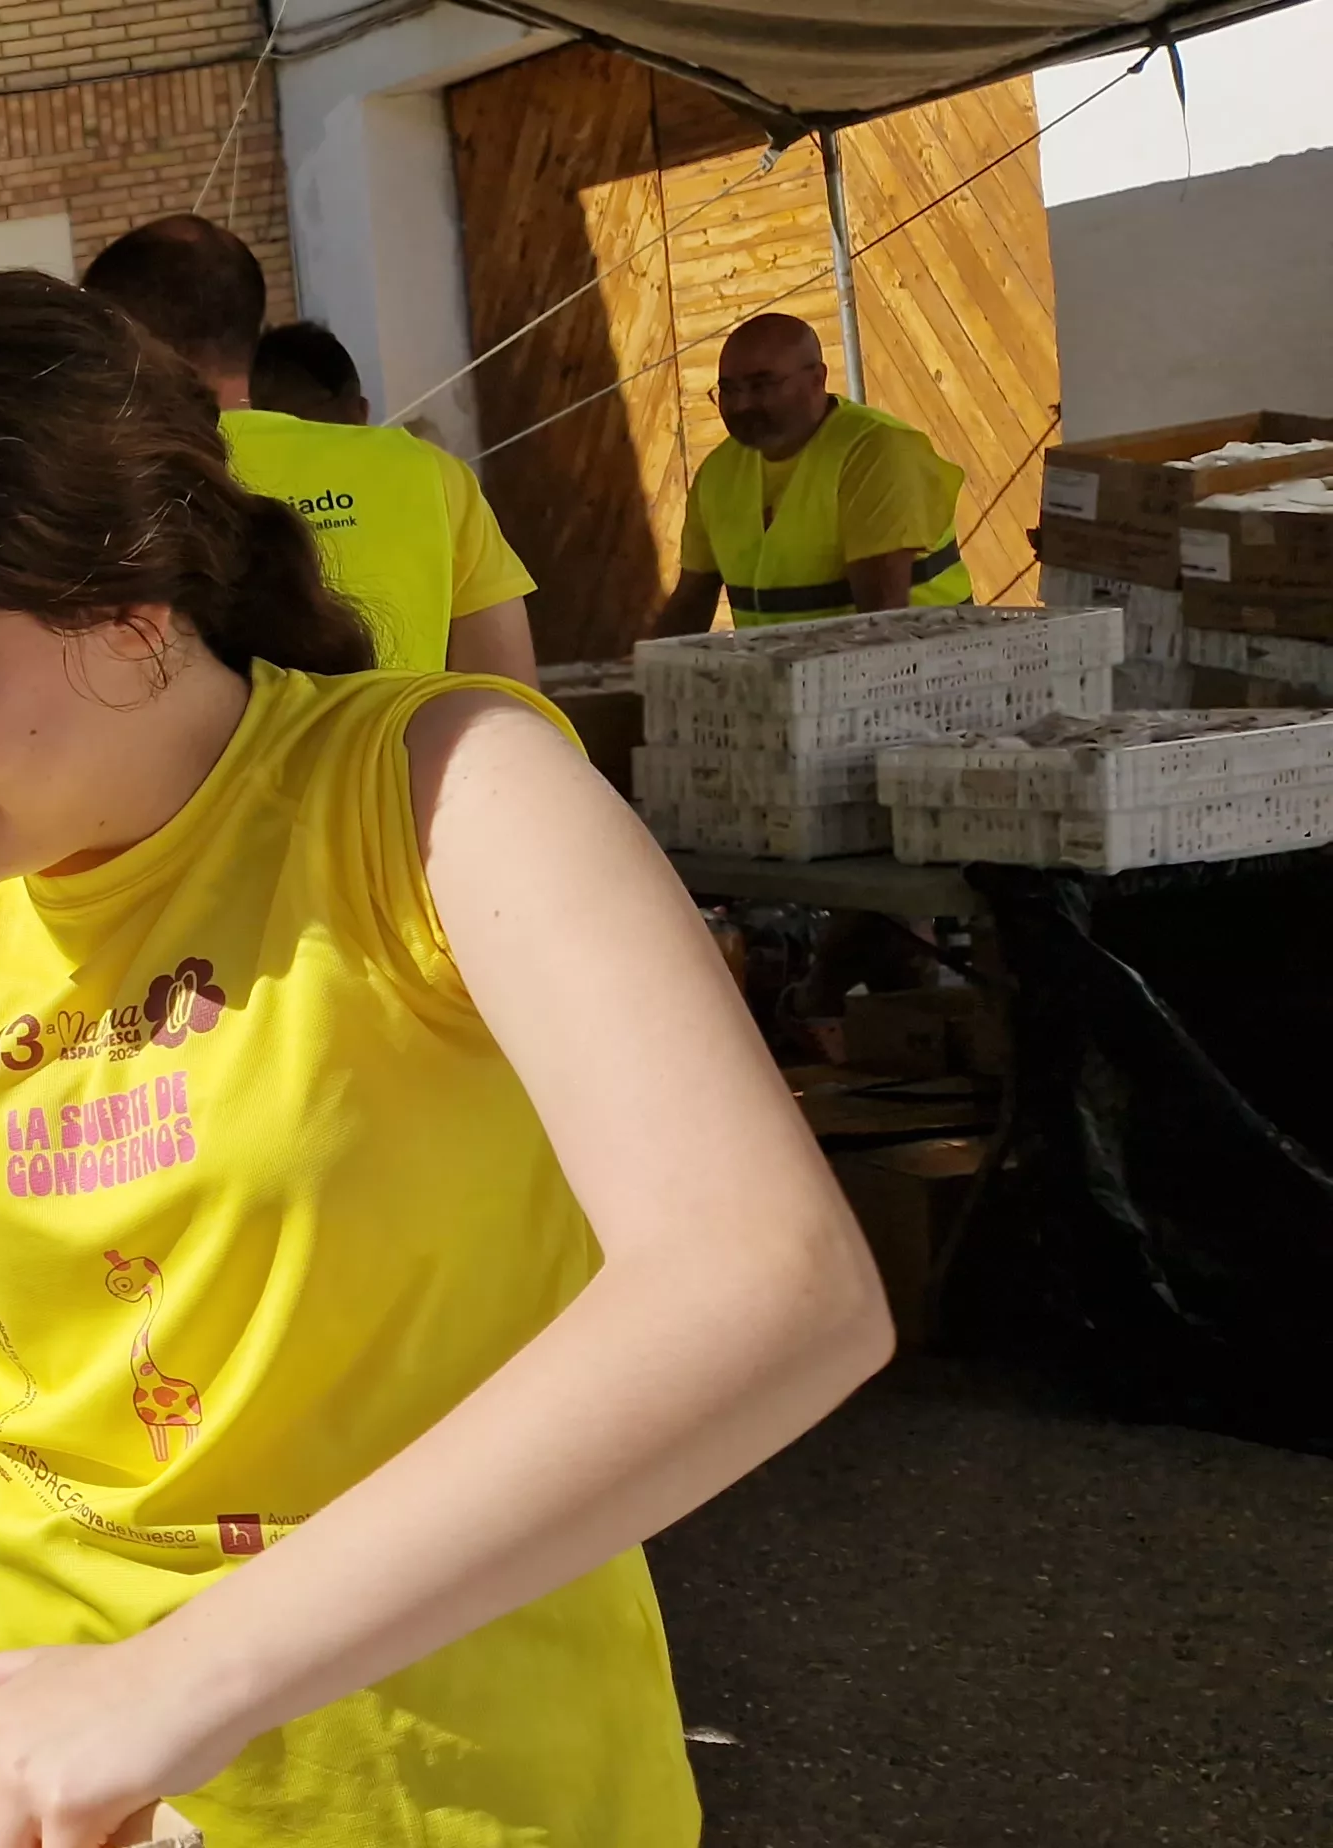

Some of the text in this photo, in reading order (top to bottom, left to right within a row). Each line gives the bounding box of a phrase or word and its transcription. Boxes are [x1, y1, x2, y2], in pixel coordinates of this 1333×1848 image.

[317, 515, 357, 530] aBank
[109, 1044, 141, 1061] 2025
[7, 1071, 188, 1151] LA SUERTE DE
[6, 1116, 195, 1197] CONOCERNOS
[127, 1526, 197, 1544] huesca
